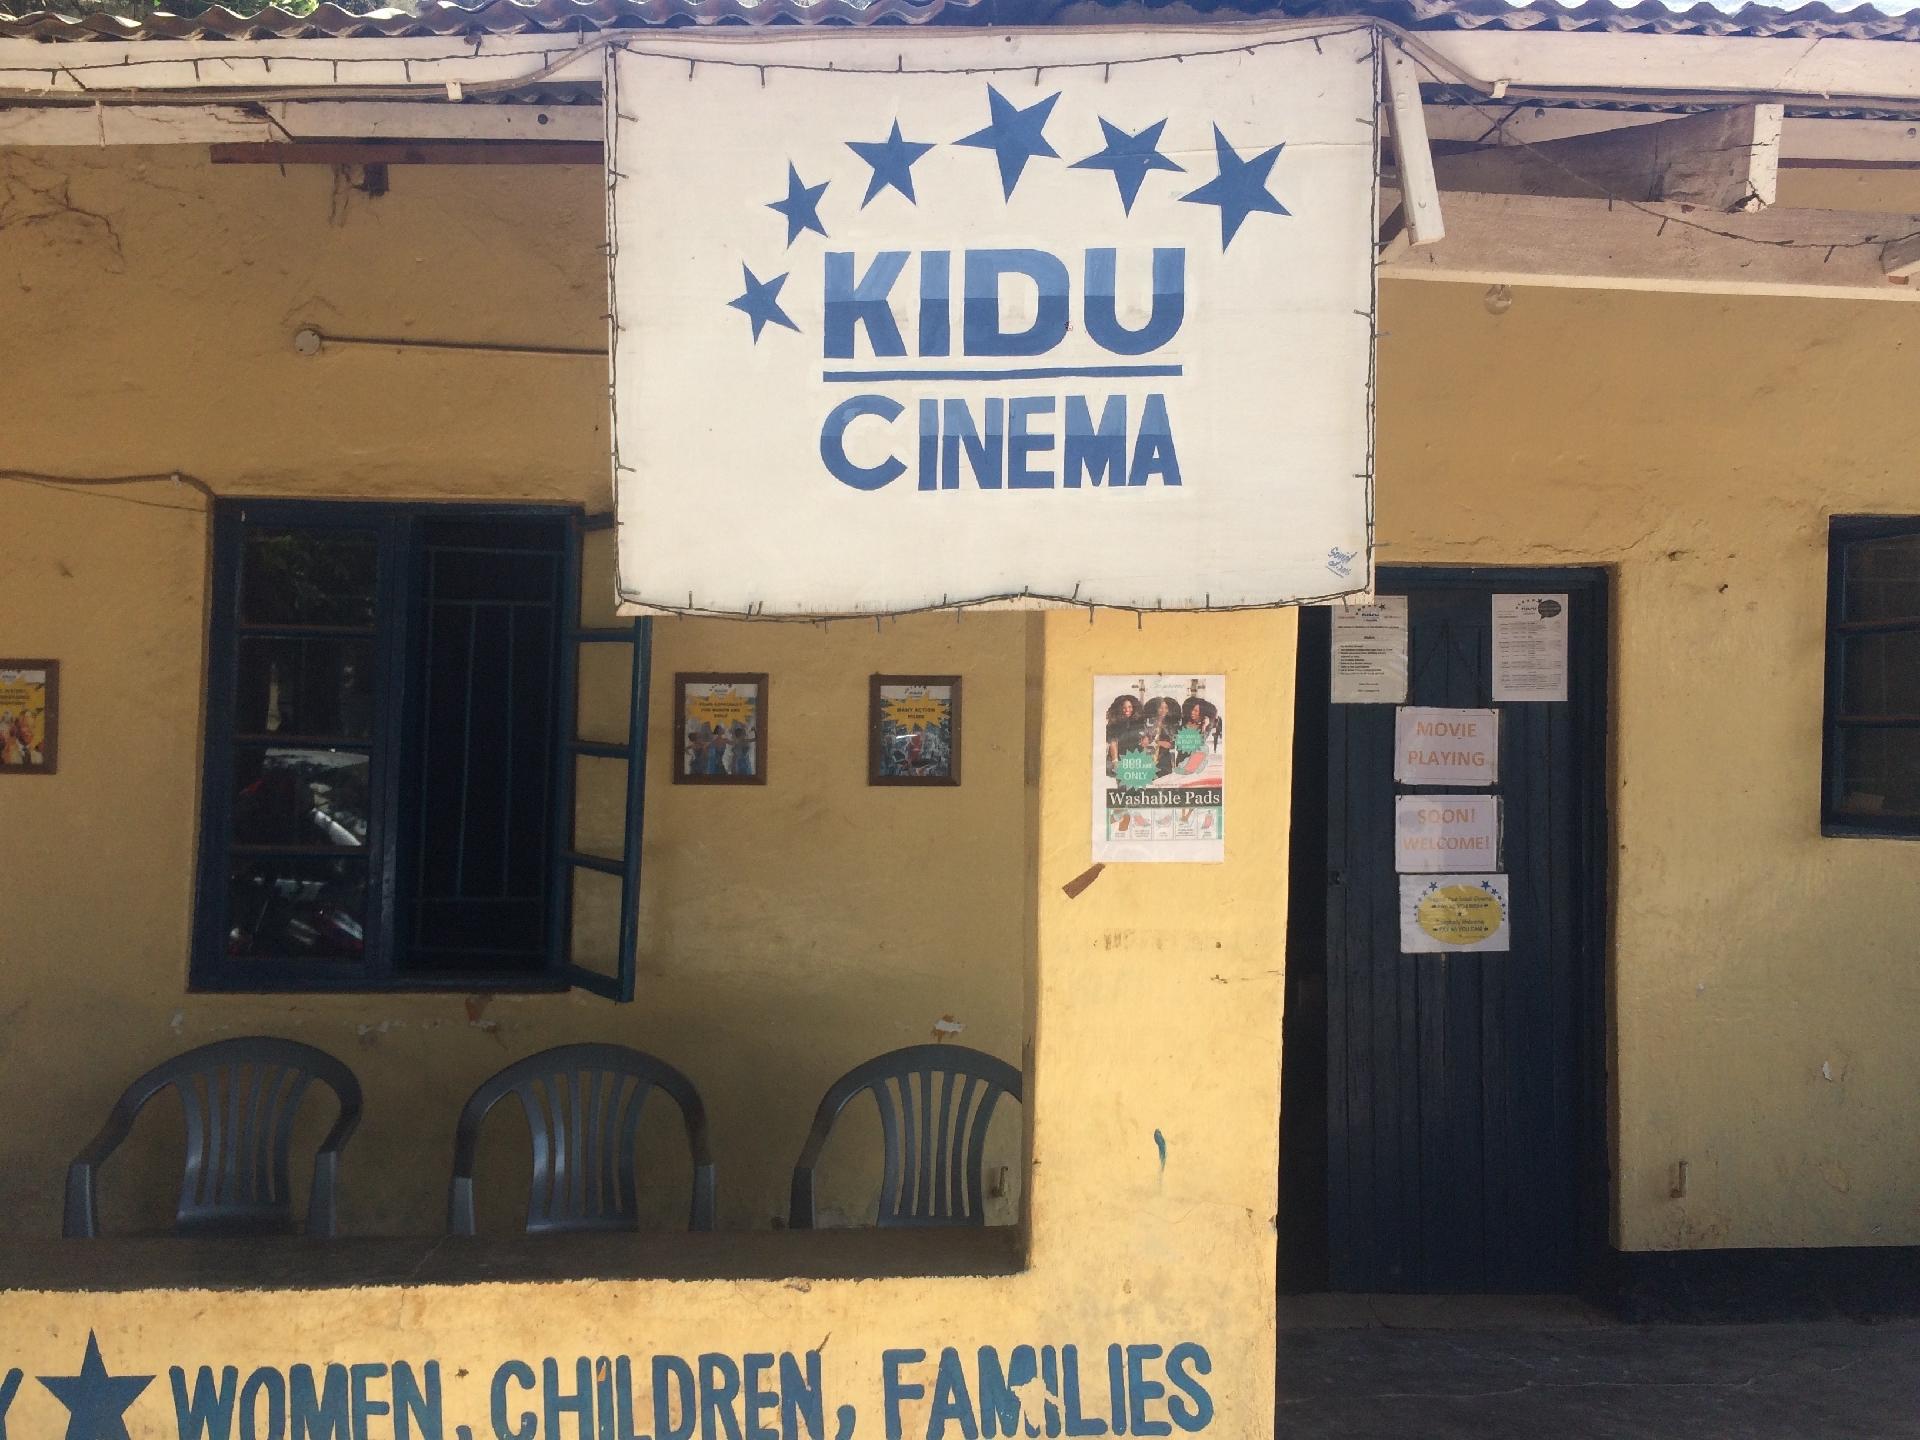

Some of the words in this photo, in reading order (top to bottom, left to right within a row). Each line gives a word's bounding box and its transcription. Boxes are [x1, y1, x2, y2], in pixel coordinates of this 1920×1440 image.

[823, 247, 1186, 360] KIDU
[820, 394, 1183, 492] CINEMA
[1416, 721, 1478, 738] MOVIE
[1408, 750, 1485, 766] PLAYING
[1123, 771, 1148, 780] ONLY
[1108, 790, 1181, 805] Washable
[1185, 790, 1220, 805] Pads
[1417, 808, 1475, 824] SOON!
[1403, 836, 1489, 850] WELCOME!
[490, 1350, 857, 1440] CHILDREN,
[882, 1342, 1213, 1440] FAMILIES
